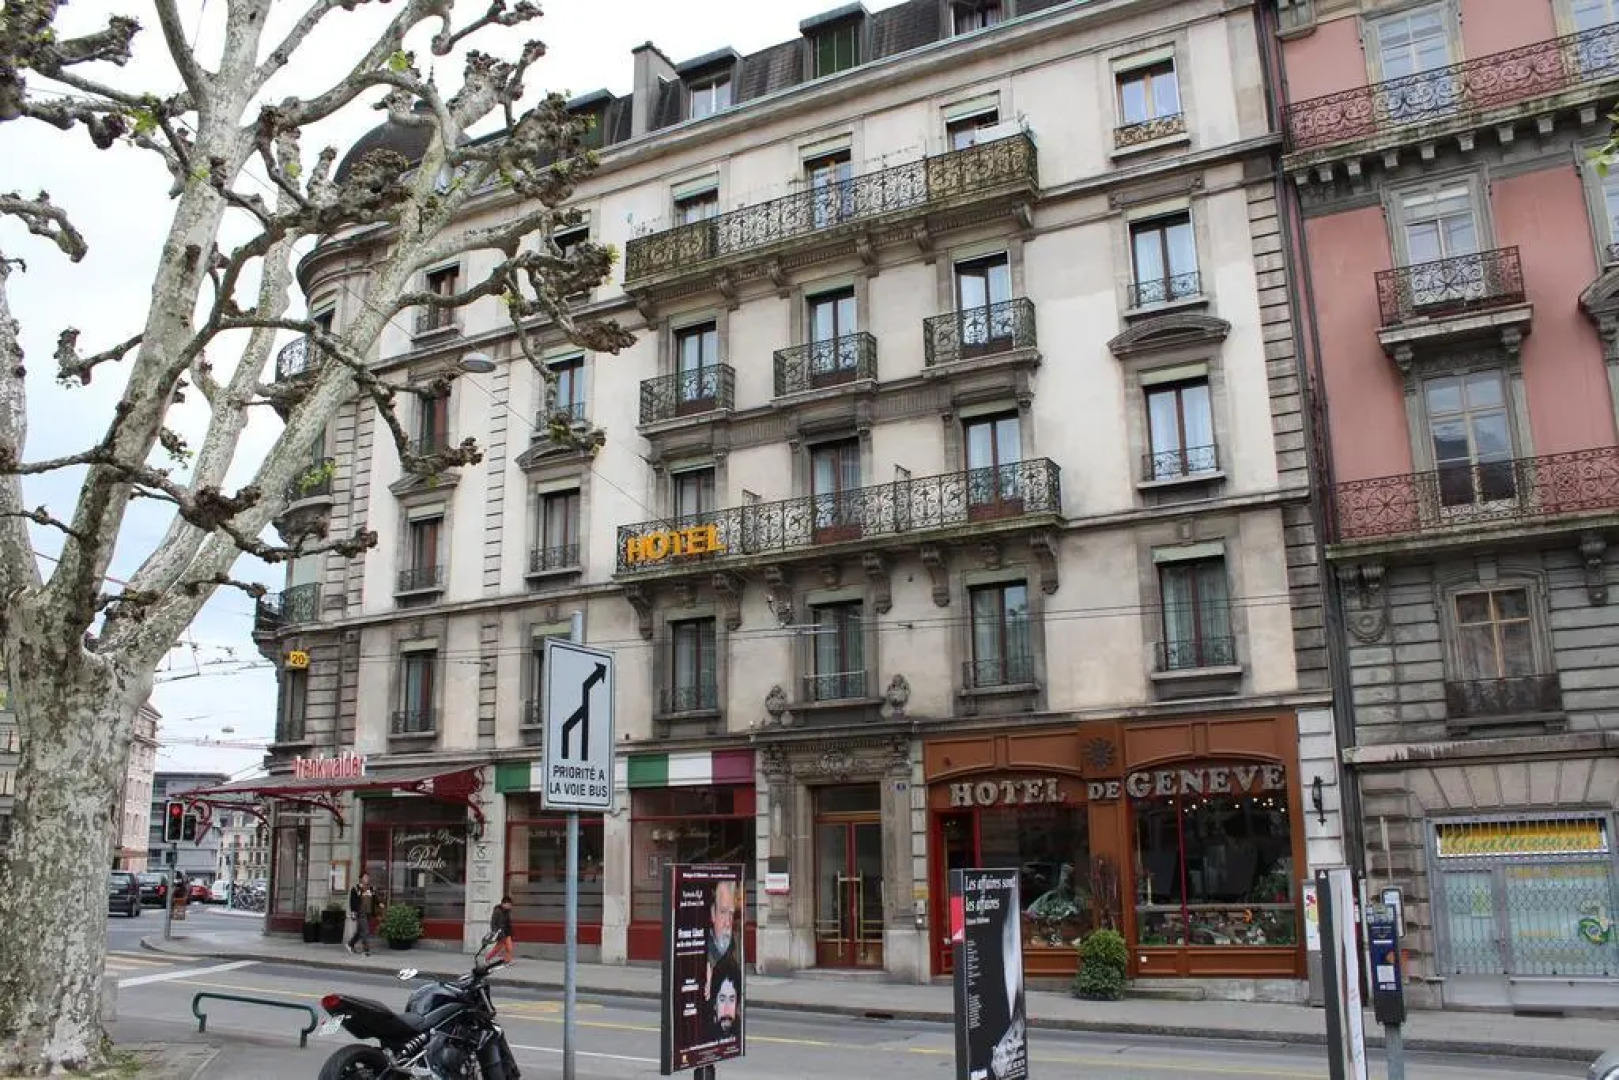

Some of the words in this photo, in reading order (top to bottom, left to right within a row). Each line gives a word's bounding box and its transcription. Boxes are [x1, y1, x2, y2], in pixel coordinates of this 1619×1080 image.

[627, 523, 727, 564] HOTEL
[292, 654, 305, 665] 20
[598, 769, 605, 780] A
[549, 782, 562, 794] LA
[564, 783, 586, 796] VOIE
[589, 784, 608, 797] BUS
[949, 778, 1065, 806] HOTEL
[1087, 781, 1120, 800] DE
[1126, 764, 1287, 798] GENEVE
[965, 876, 976, 890] Les
